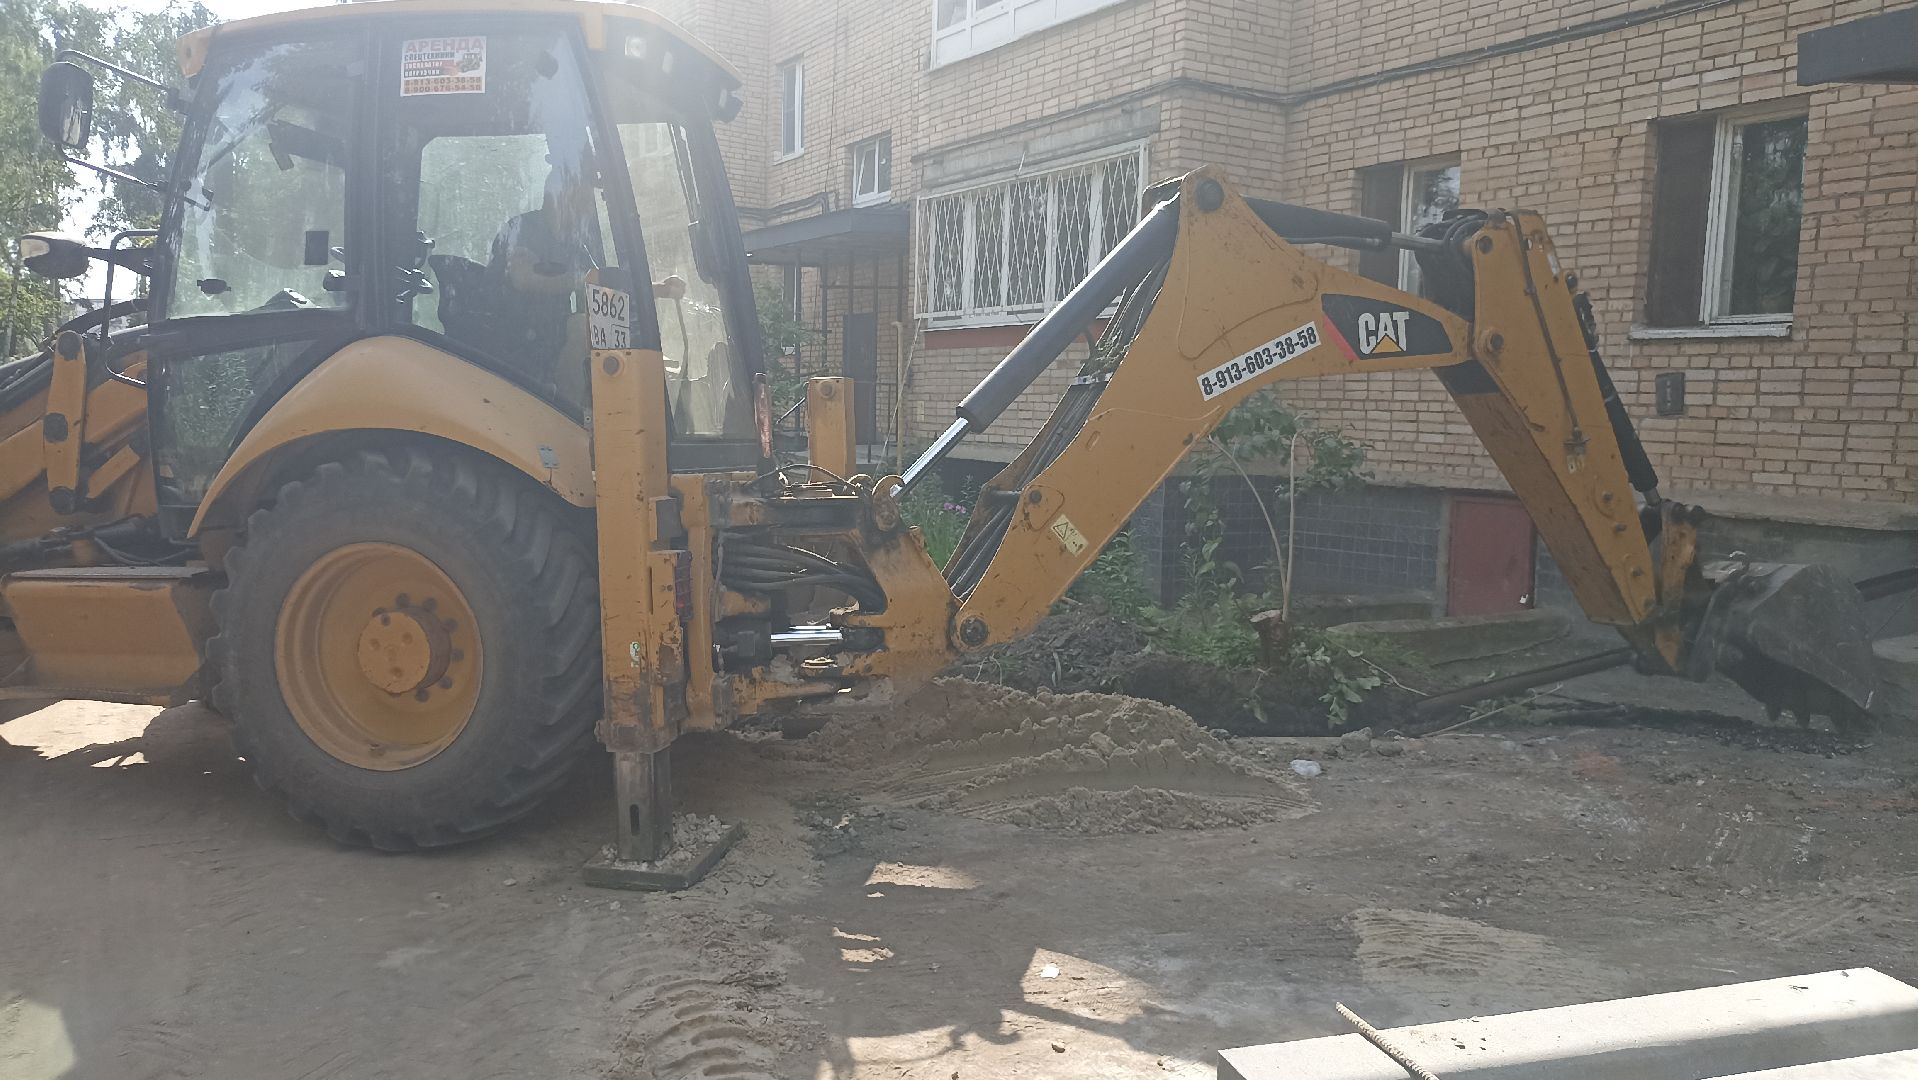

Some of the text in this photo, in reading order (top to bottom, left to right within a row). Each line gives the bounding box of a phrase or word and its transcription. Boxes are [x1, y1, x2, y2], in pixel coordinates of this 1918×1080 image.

[406, 39, 483, 53] АРЕНДА
[592, 289, 625, 321] 5862
[614, 329, 626, 348] 33
[1358, 312, 1409, 355] CAT
[1201, 327, 1317, 396] 8-913-603-38-58
